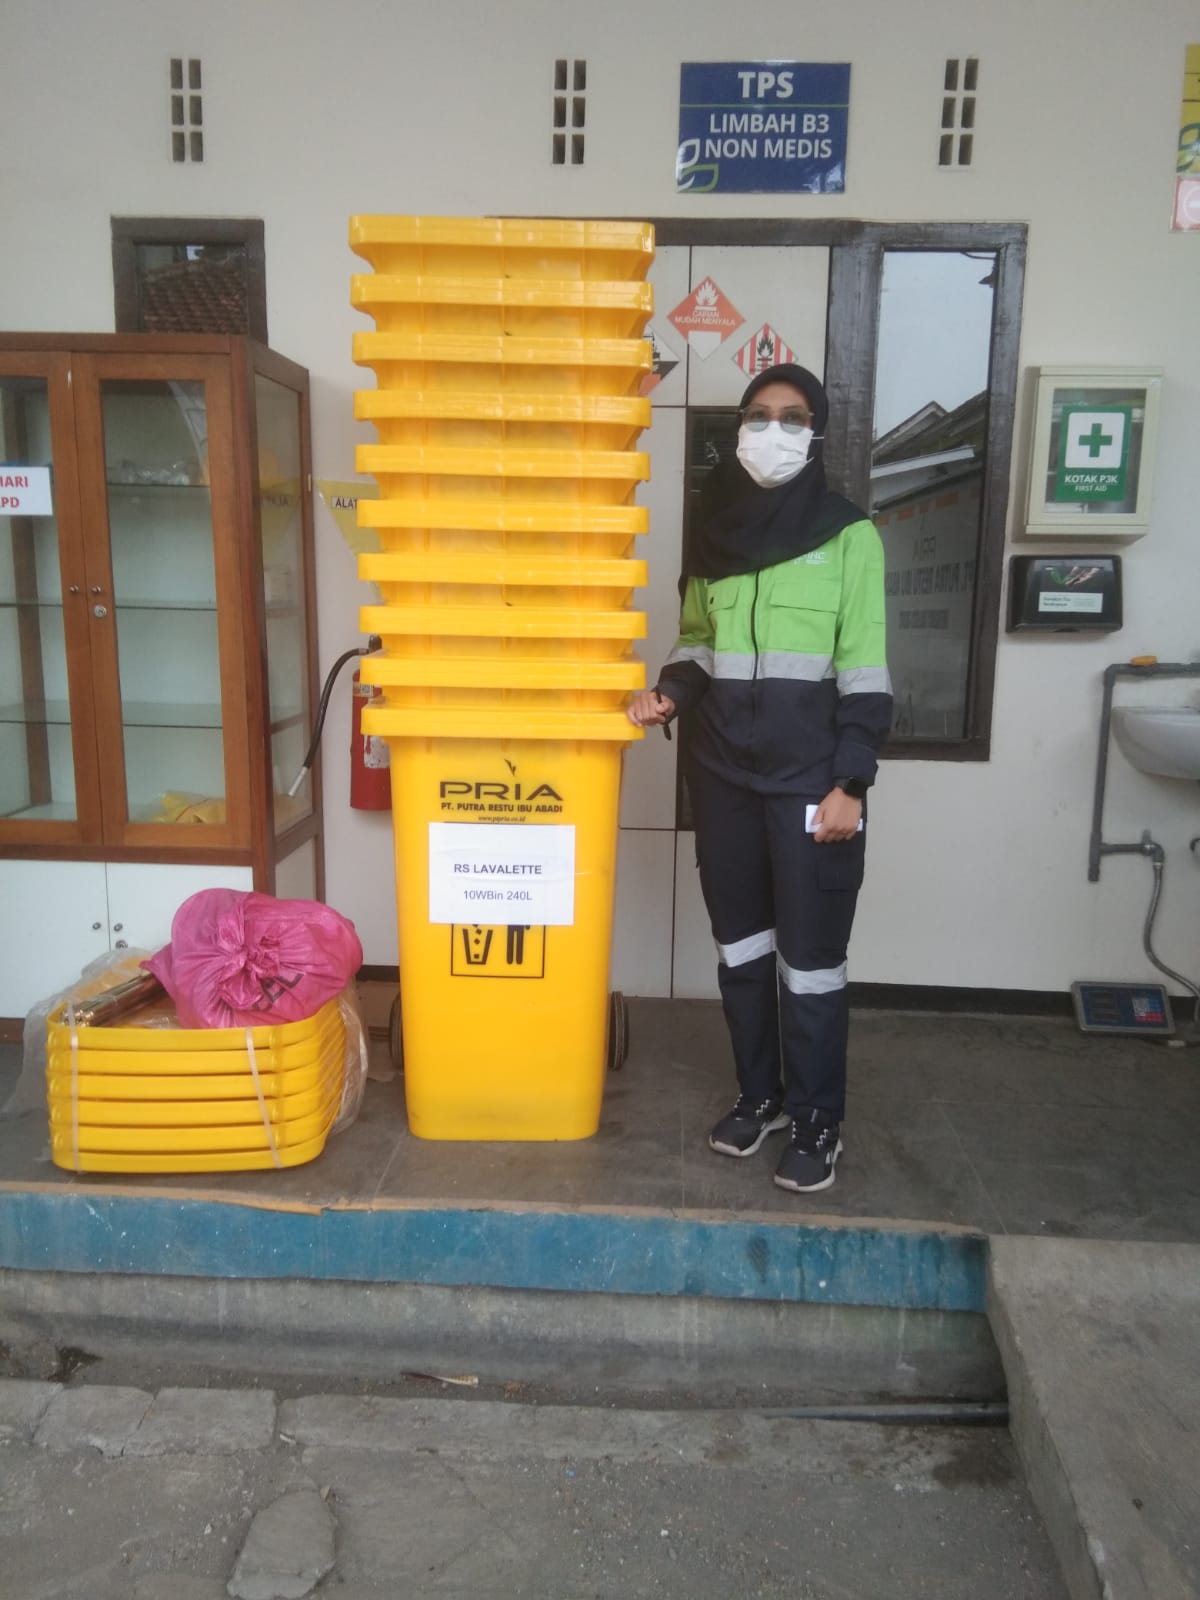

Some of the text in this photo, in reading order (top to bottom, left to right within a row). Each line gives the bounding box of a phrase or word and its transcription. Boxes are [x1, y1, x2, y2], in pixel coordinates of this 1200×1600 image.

[737, 71, 794, 99] TPS
[709, 113, 830, 134] LIMBAH B3
[704, 138, 832, 159] NON MEDIS
[1064, 474, 1119, 484] KOTAK P3K
[440, 781, 563, 801] PRIA
[441, 802, 563, 814] PT. PUTRA RESTU IBU ABADI
[453, 863, 542, 875] RS LAVALETTE
[463, 890, 533, 901] 10WBin 240L
